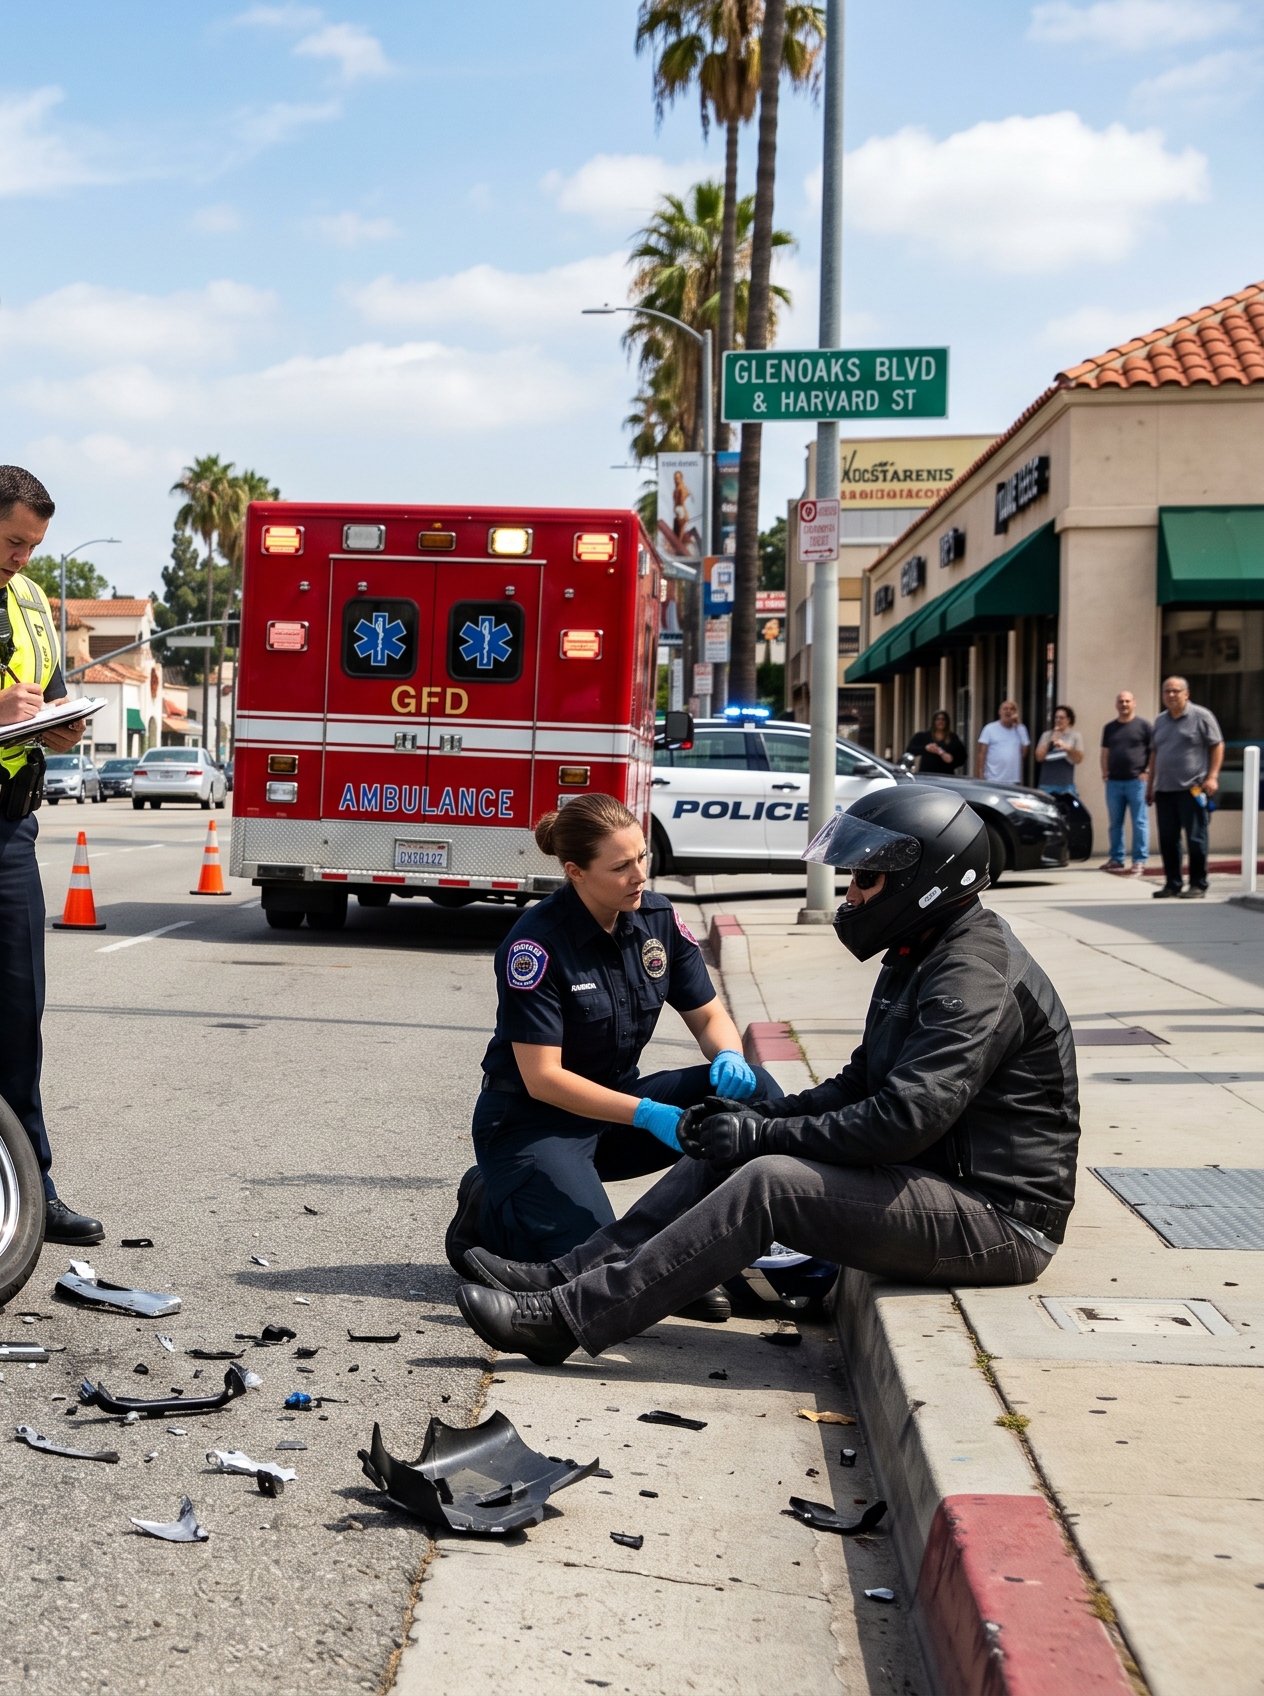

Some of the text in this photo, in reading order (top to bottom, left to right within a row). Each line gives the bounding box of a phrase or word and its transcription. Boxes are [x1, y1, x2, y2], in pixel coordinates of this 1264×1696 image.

[735, 356, 936, 384] GLENOAKS BLVD
[752, 389, 917, 413] & HARVARD ST
[391, 685, 469, 715] GFD
[339, 783, 513, 818] AMBULANCE
[672, 800, 809, 821] POLICE
